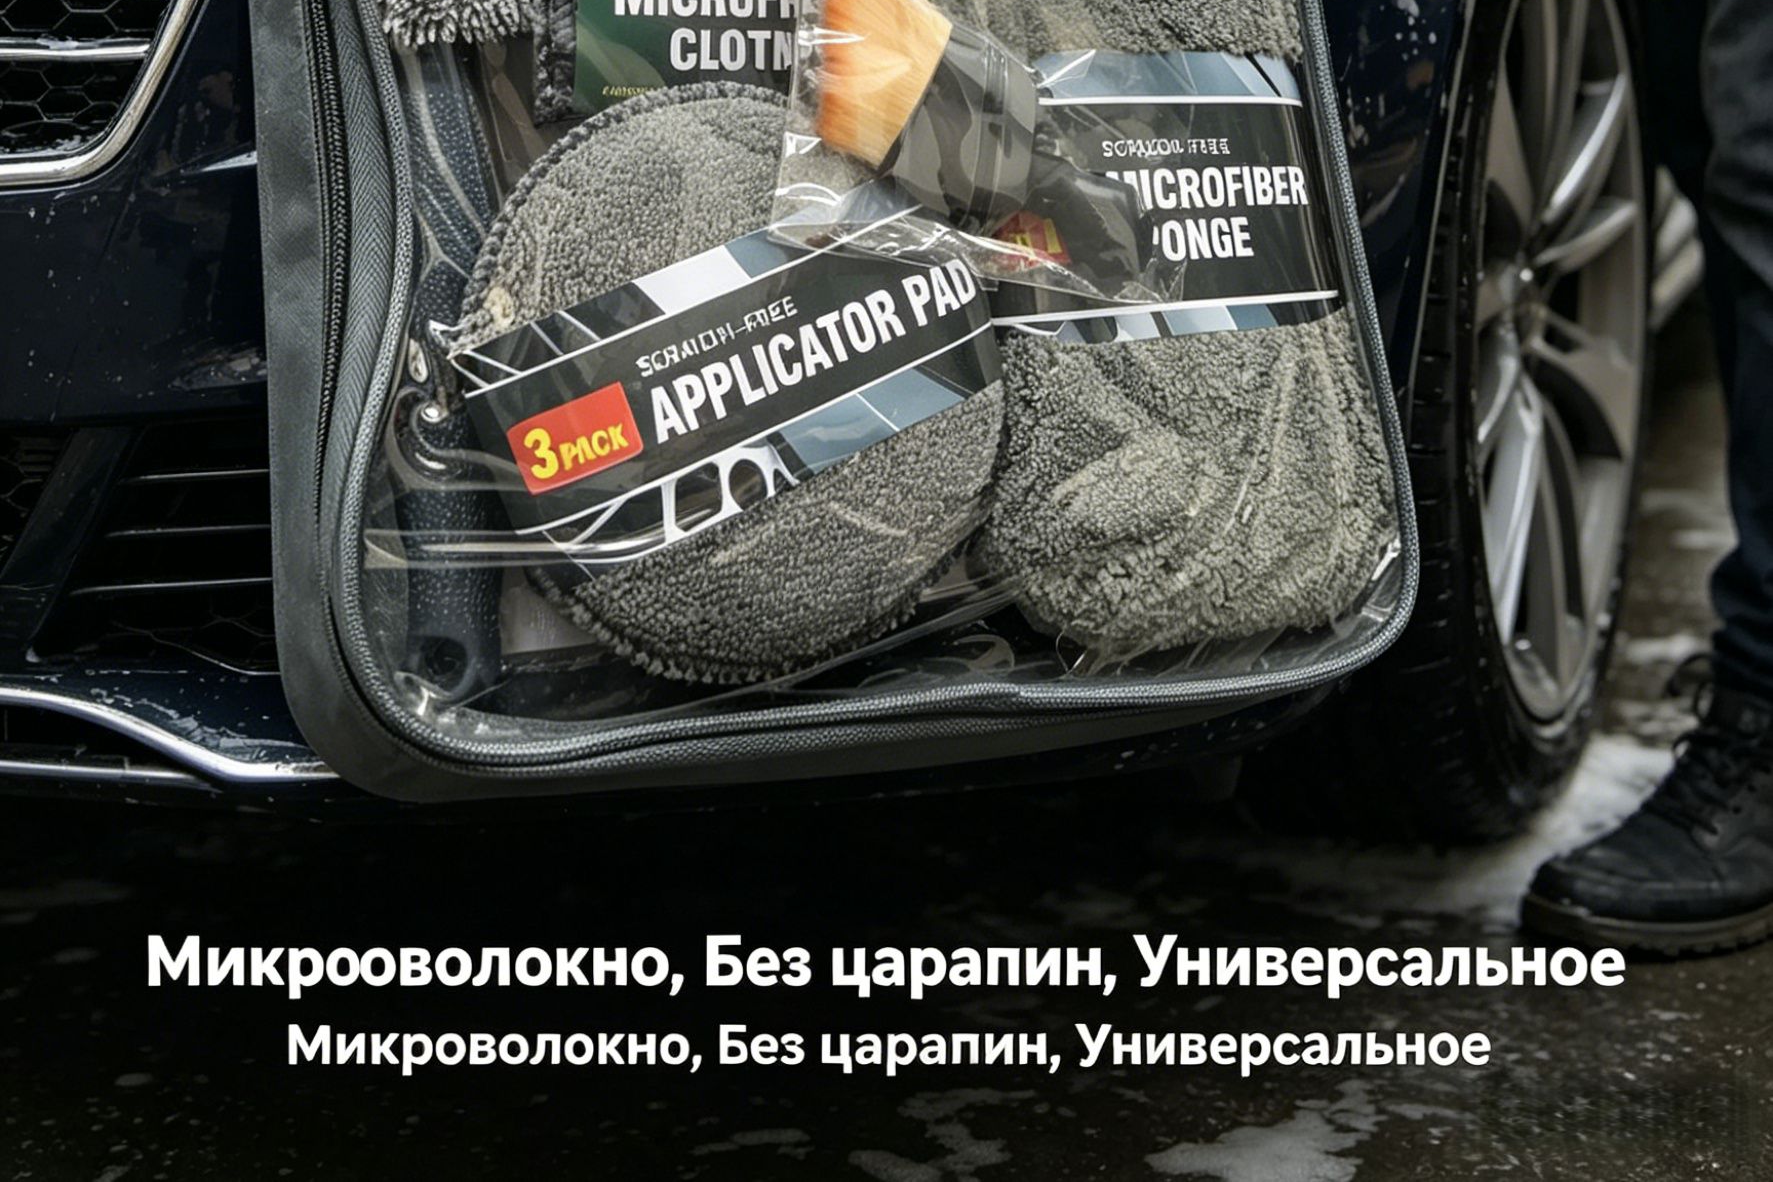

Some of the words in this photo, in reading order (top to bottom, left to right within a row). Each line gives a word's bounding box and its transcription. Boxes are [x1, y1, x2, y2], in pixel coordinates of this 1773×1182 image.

[650, 288, 906, 444] APPLICATOR
[901, 258, 976, 327] PAD
[523, 428, 559, 479] 3
[559, 423, 629, 471] PACK
